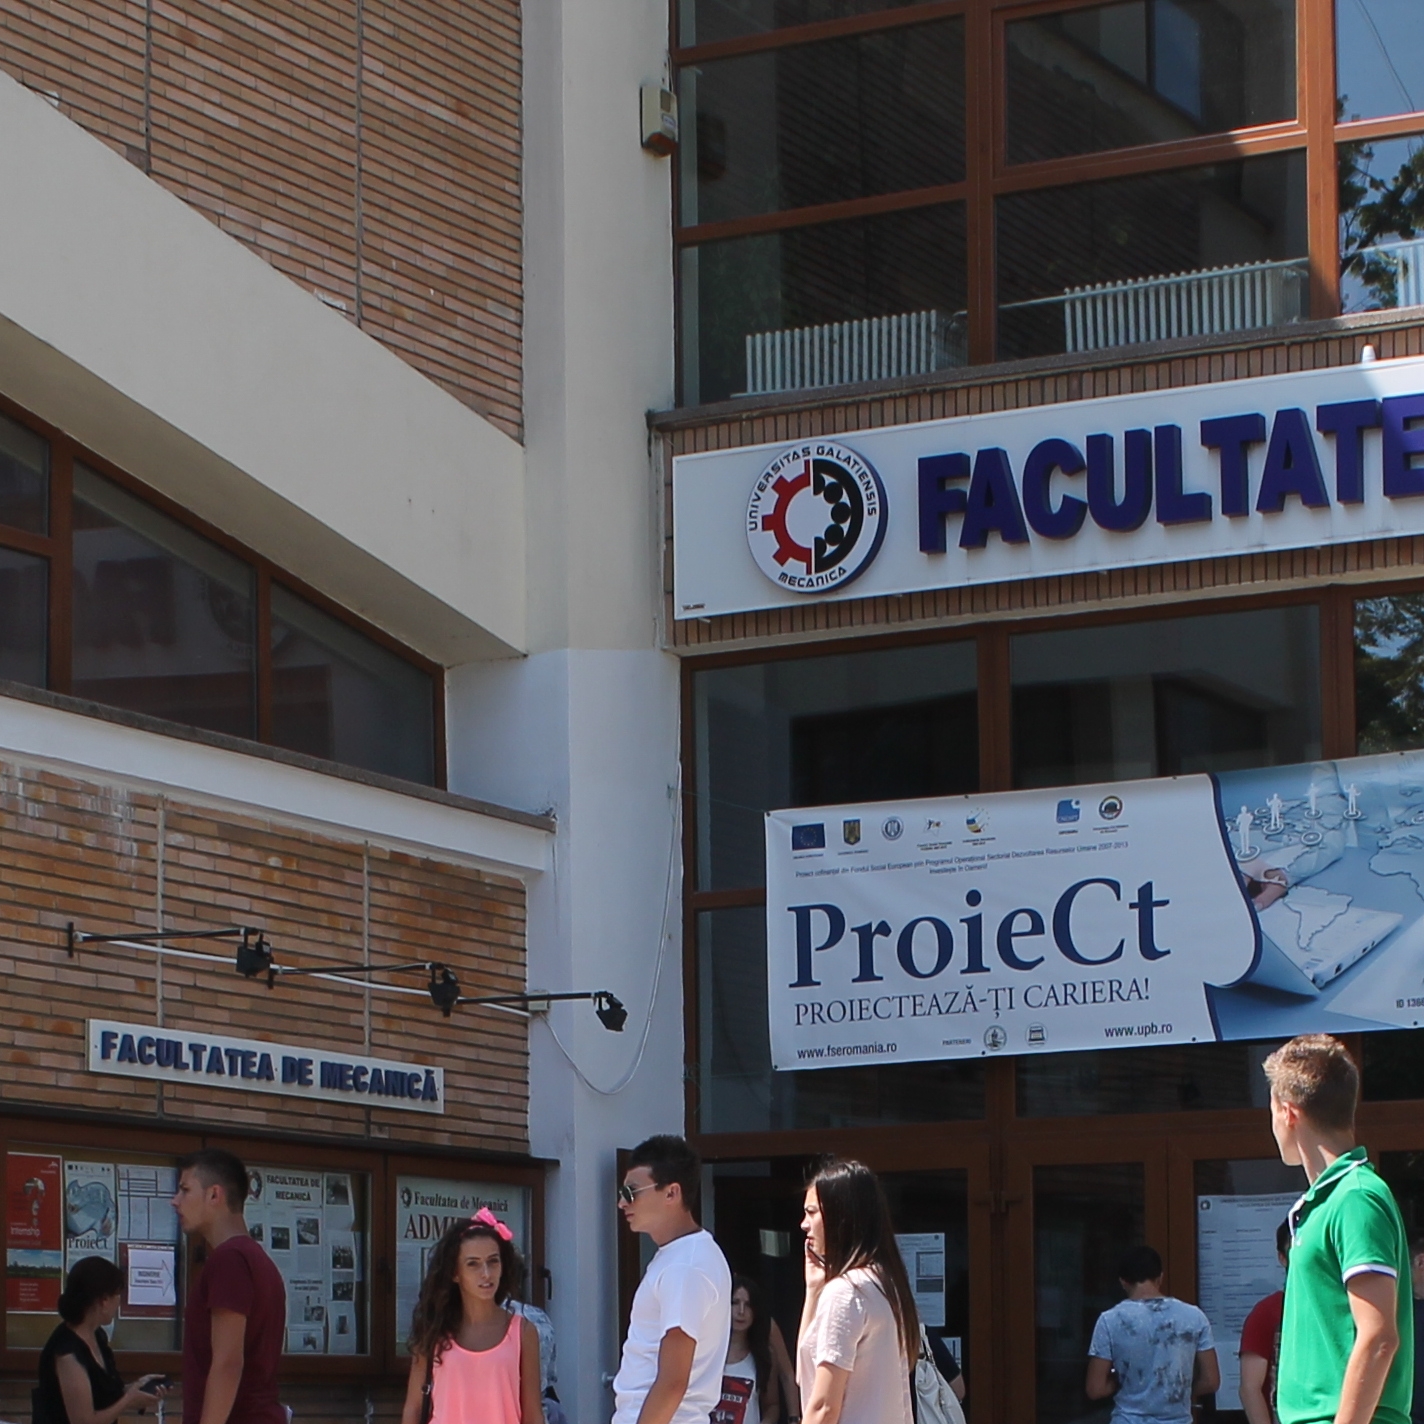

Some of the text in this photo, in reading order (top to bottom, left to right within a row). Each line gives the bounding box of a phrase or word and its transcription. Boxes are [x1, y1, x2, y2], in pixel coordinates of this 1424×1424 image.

[748, 445, 877, 531] UNIVERSITAS GALATIENSIS
[777, 566, 847, 588] MECANICA
[887, 859, 913, 870] European
[925, 855, 953, 867] Programul
[1012, 848, 1044, 859] Dezvoltarea
[1045, 845, 1075, 856] Resurselor
[1076, 843, 1097, 852] Umane
[787, 877, 1172, 989] ProieCt
[794, 977, 1150, 1026] PROIECTEAZĂ-ȚI CARIERA!
[1396, 998, 1405, 1008] ID
[797, 1042, 898, 1060] www.fseromania.ro
[1104, 1022, 1173, 1039] www.upb.ro
[100, 1030, 439, 1102] FACULTATEA DE MECANICĂ
[266, 1174, 320, 1188] FACULTATEA DE
[414, 1191, 458, 1208] Facultatea
[460, 1195, 469, 1209] de
